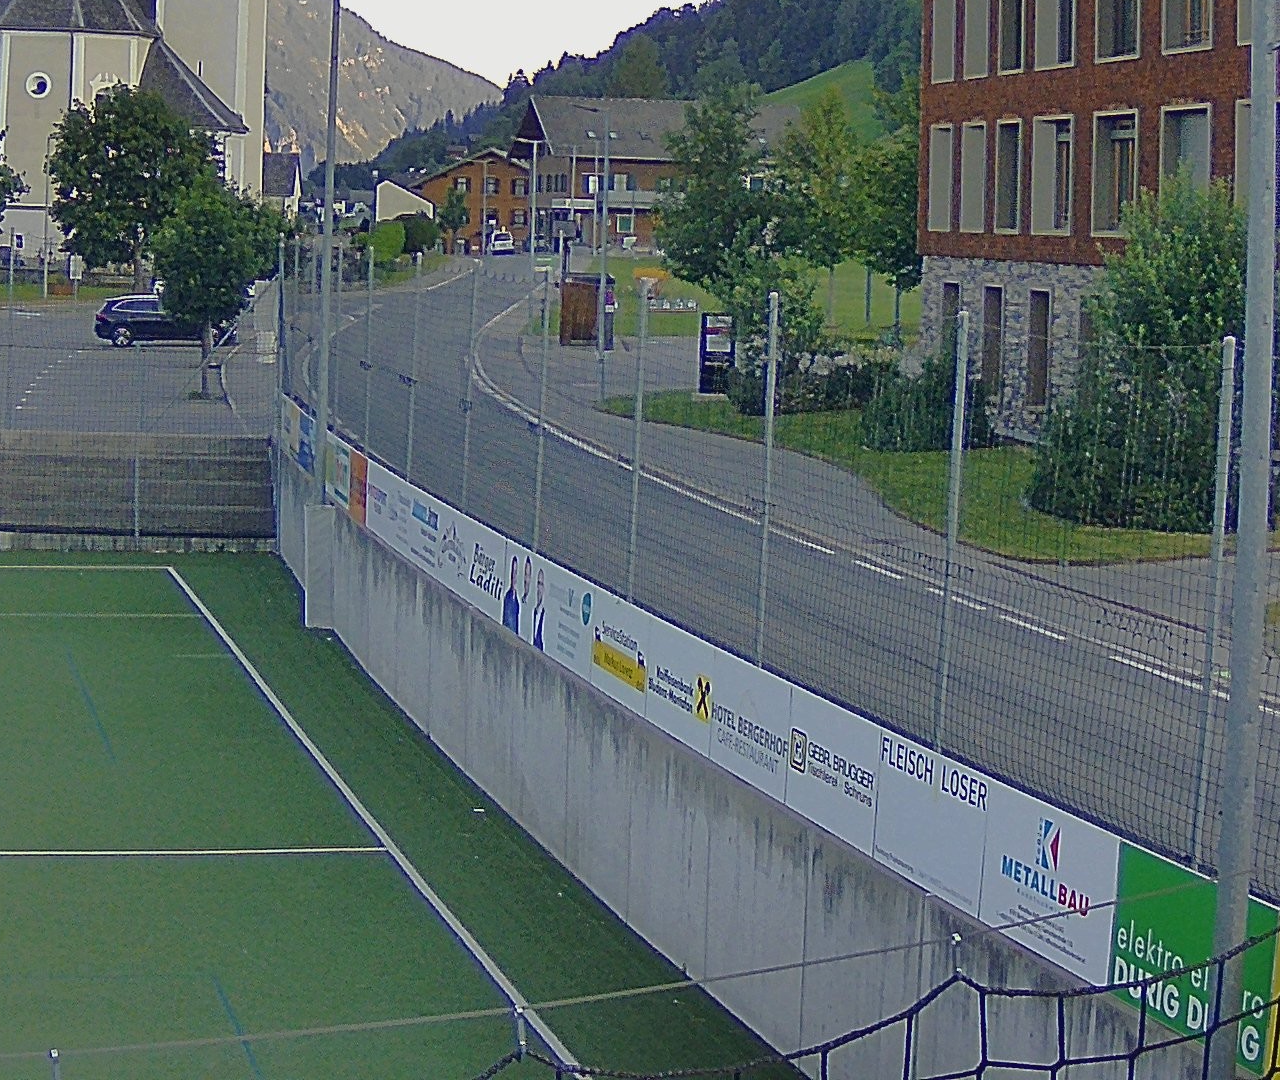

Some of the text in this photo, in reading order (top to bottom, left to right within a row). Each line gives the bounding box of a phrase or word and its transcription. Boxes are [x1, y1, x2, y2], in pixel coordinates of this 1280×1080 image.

[712, 702, 789, 758] HOTEL BERGERHOF
[833, 754, 874, 791] BRUGGER
[844, 781, 872, 808] Schruns
[881, 736, 987, 812] FLEISCH LOSER
[1002, 854, 1090, 917] METALLBAU
[1117, 919, 1183, 971] elektro
